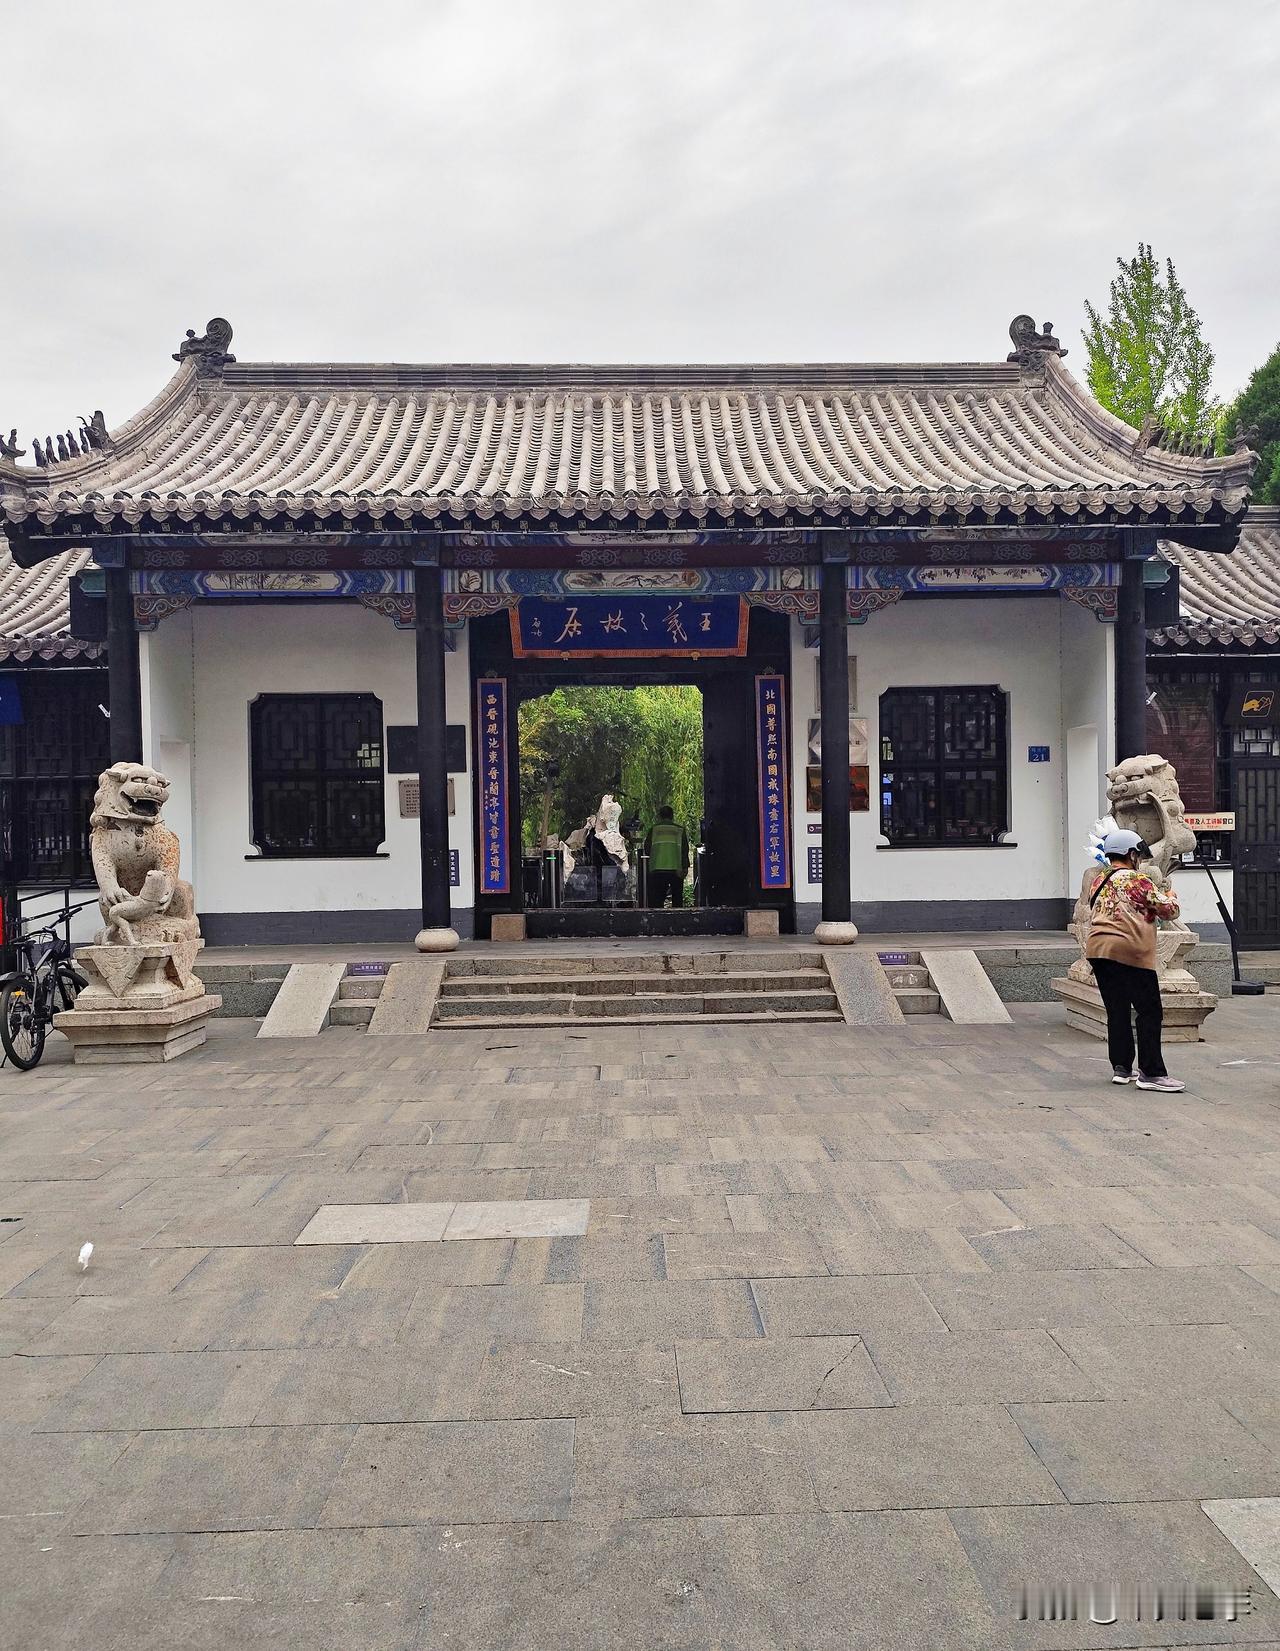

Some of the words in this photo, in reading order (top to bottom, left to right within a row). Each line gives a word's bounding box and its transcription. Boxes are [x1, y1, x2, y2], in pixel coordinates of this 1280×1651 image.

[553, 601, 712, 643] 王羲之故居
[1032, 753, 1045, 761] 21
